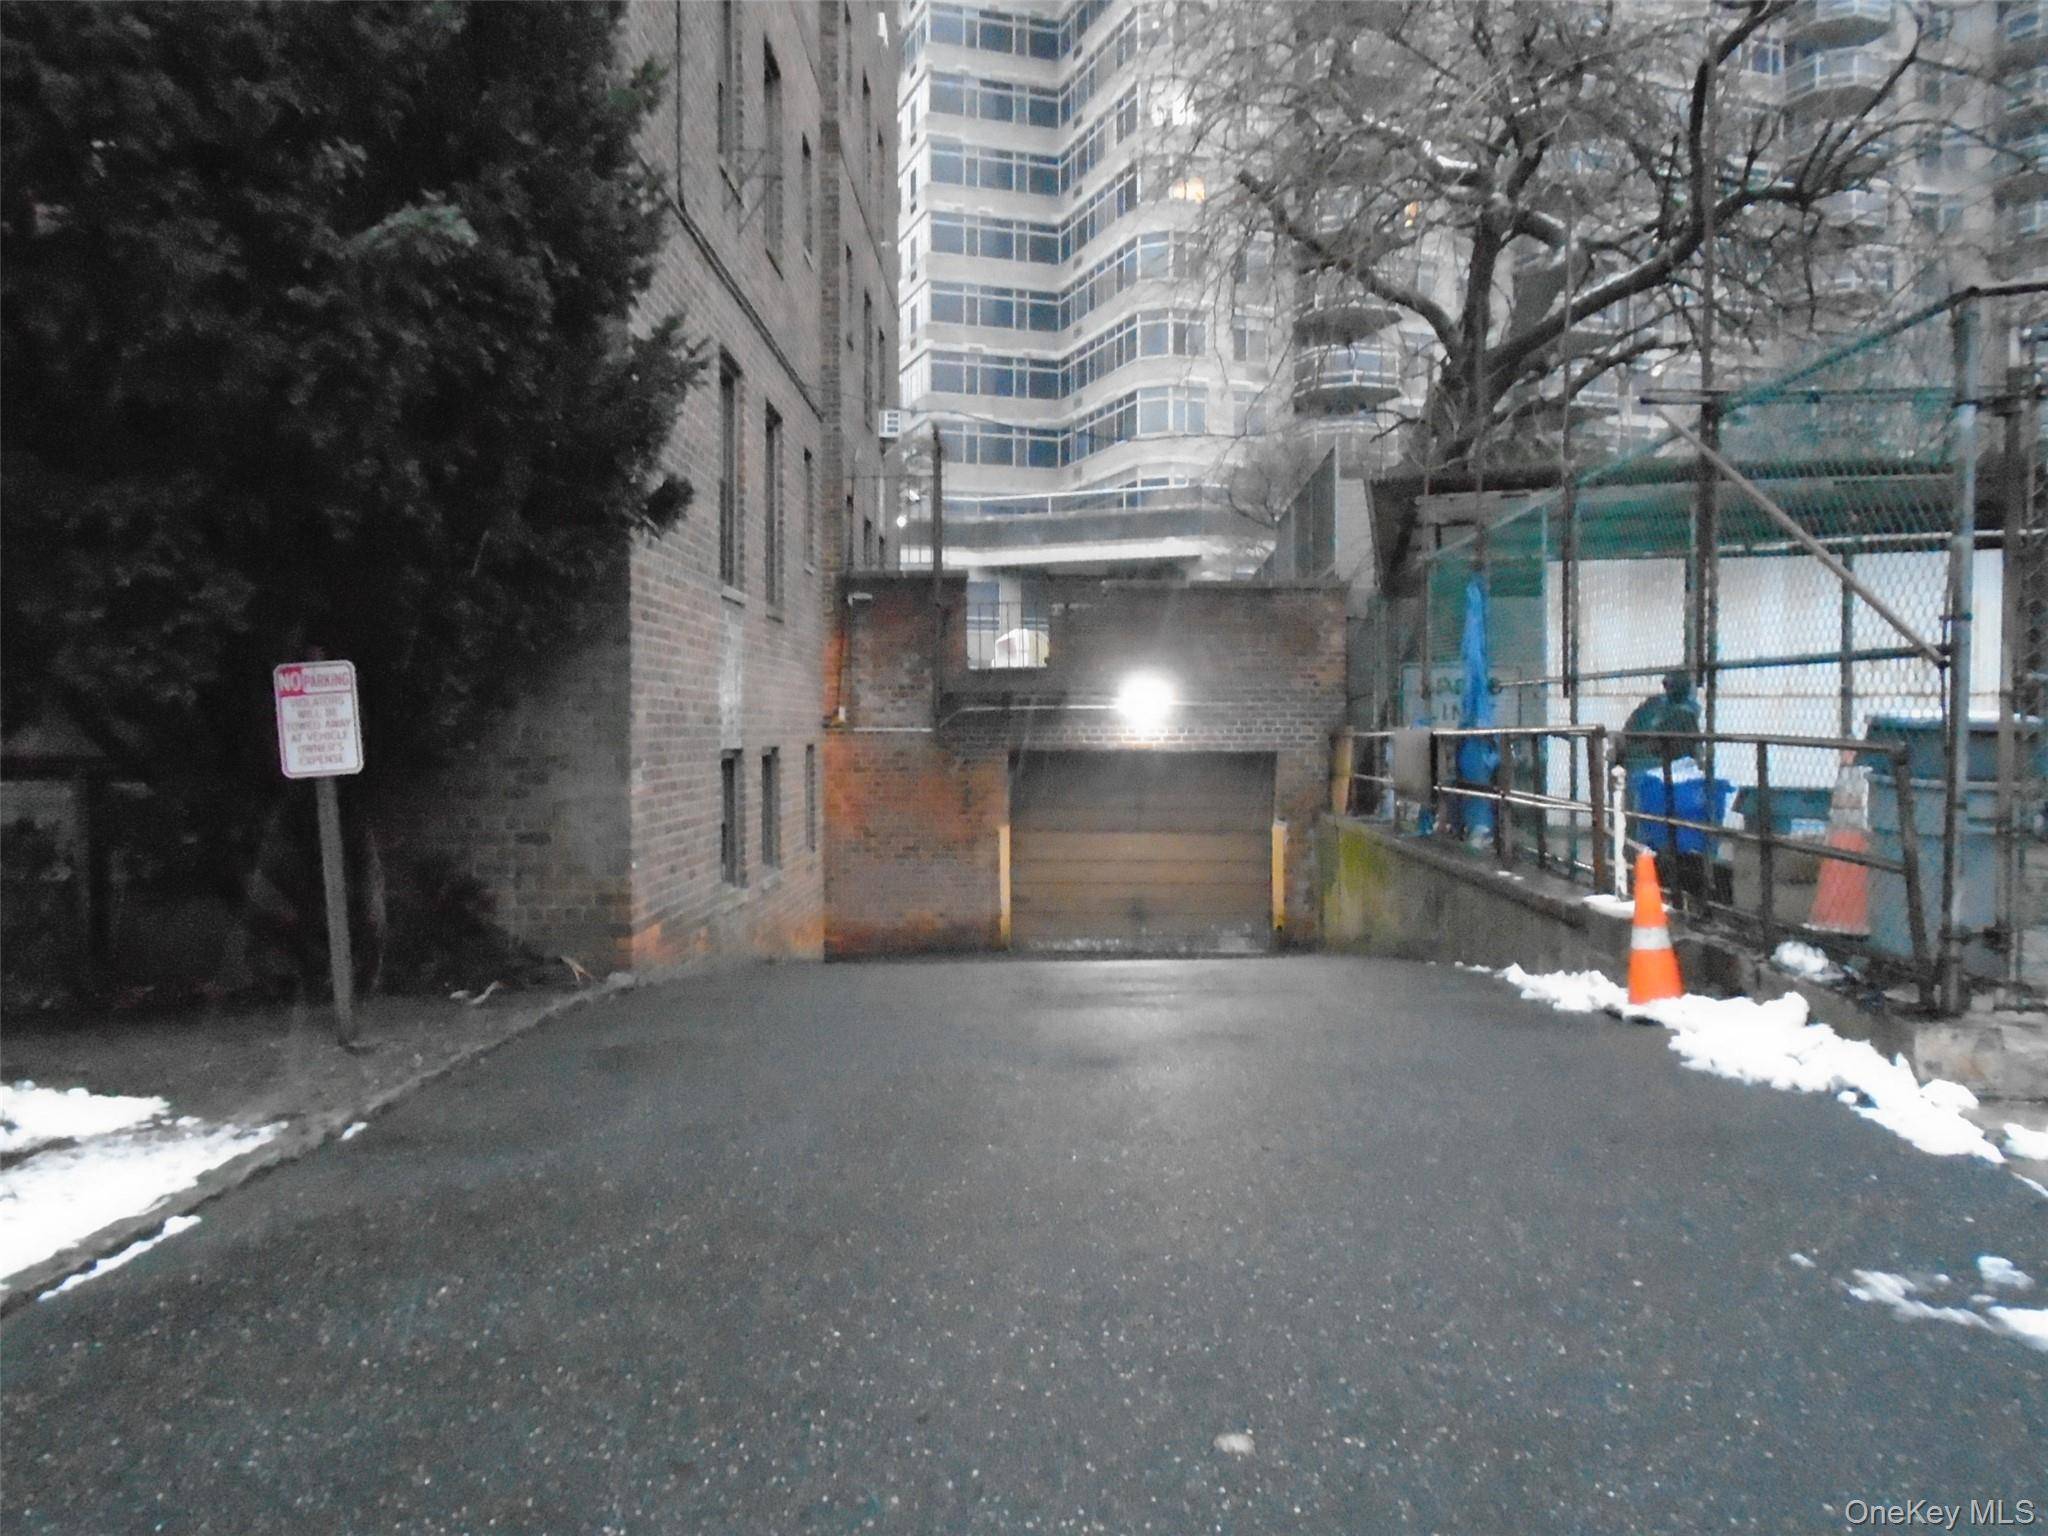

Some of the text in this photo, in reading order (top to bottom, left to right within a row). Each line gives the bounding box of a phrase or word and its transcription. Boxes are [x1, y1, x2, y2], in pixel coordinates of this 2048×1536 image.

[279, 671, 350, 691] NO PARKING
[287, 718, 351, 732] TOWED AWAY
[306, 730, 347, 743] VEHICLE
